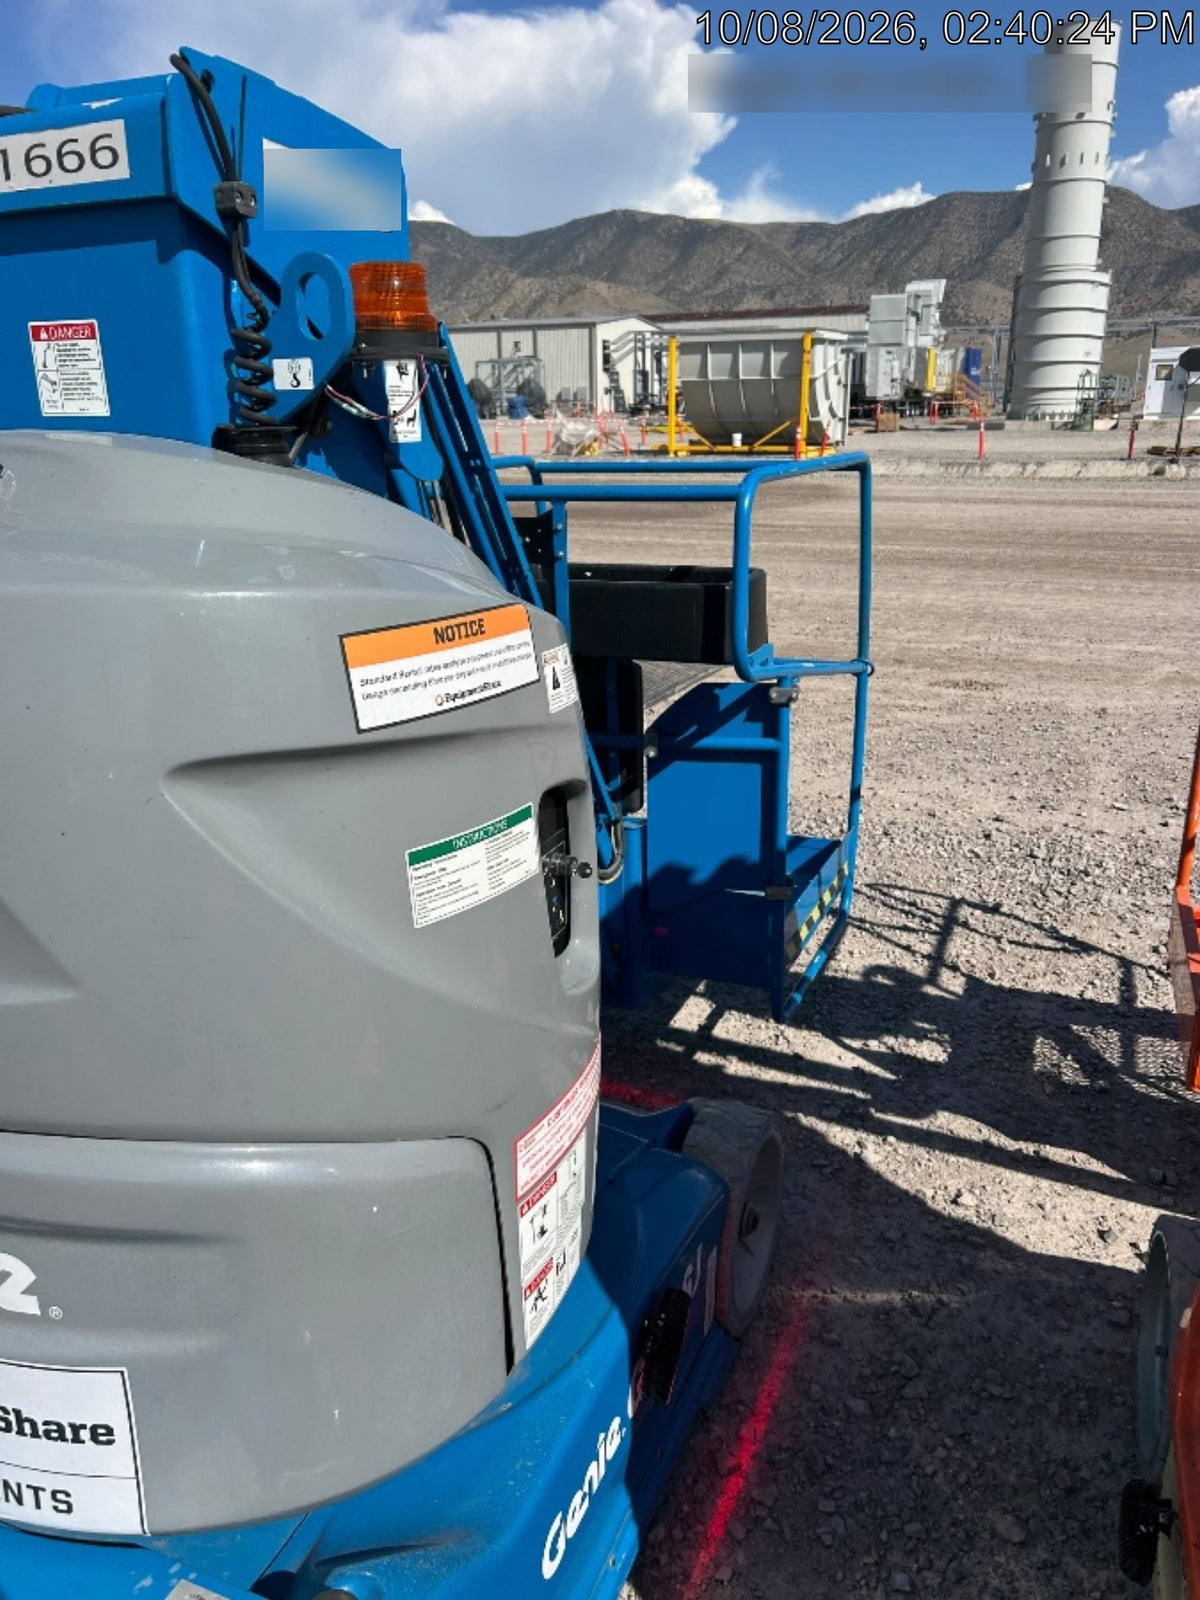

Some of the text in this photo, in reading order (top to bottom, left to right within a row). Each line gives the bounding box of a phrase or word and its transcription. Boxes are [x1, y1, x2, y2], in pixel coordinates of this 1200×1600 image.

[0, 133, 119, 181] 1666
[49, 326, 92, 340] DANGER
[433, 618, 486, 645] NOTICE
[3, 1478, 74, 1515] NTS
[542, 1415, 622, 1580] Genie
